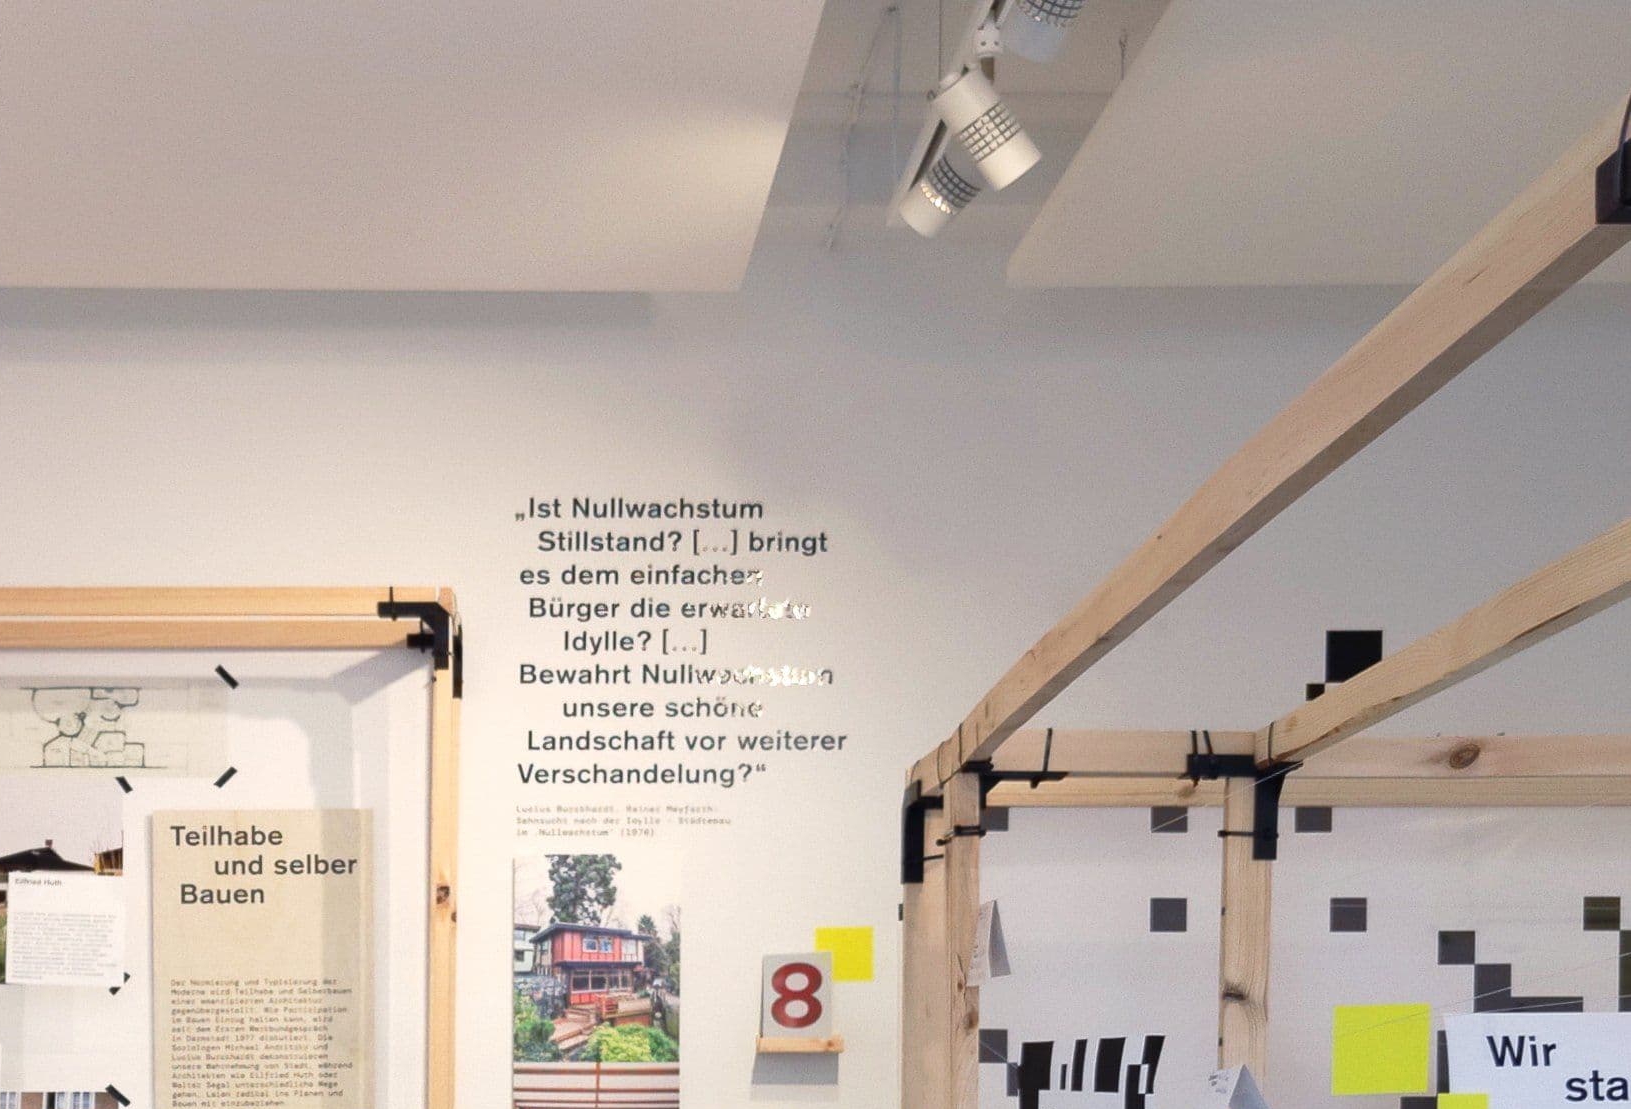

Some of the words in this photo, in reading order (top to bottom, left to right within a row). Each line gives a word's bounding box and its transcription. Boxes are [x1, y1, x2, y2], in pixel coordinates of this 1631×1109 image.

[515, 497, 561, 522] „Ist
[572, 497, 763, 519] Nullwachstum
[538, 530, 682, 552] Stillstand?
[749, 531, 828, 557] bringt
[520, 569, 550, 585] es
[561, 564, 619, 585] dem
[529, 597, 619, 622] Bürger
[631, 597, 670, 618] die
[564, 630, 651, 655] Idylle?
[520, 664, 631, 685] Bewahrt
[563, 700, 654, 718] unsere
[528, 730, 674, 752] Landschaft
[685, 734, 726, 751] vor
[738, 731, 847, 751] weiterer
[518, 763, 766, 788] Verschandelung?“
[170, 825, 283, 846] Teilhabe
[215, 855, 263, 875] und
[274, 854, 357, 875] selber
[180, 884, 265, 904] Bauen
[771, 962, 822, 1028] 8
[1487, 1035, 1556, 1067] Wir
